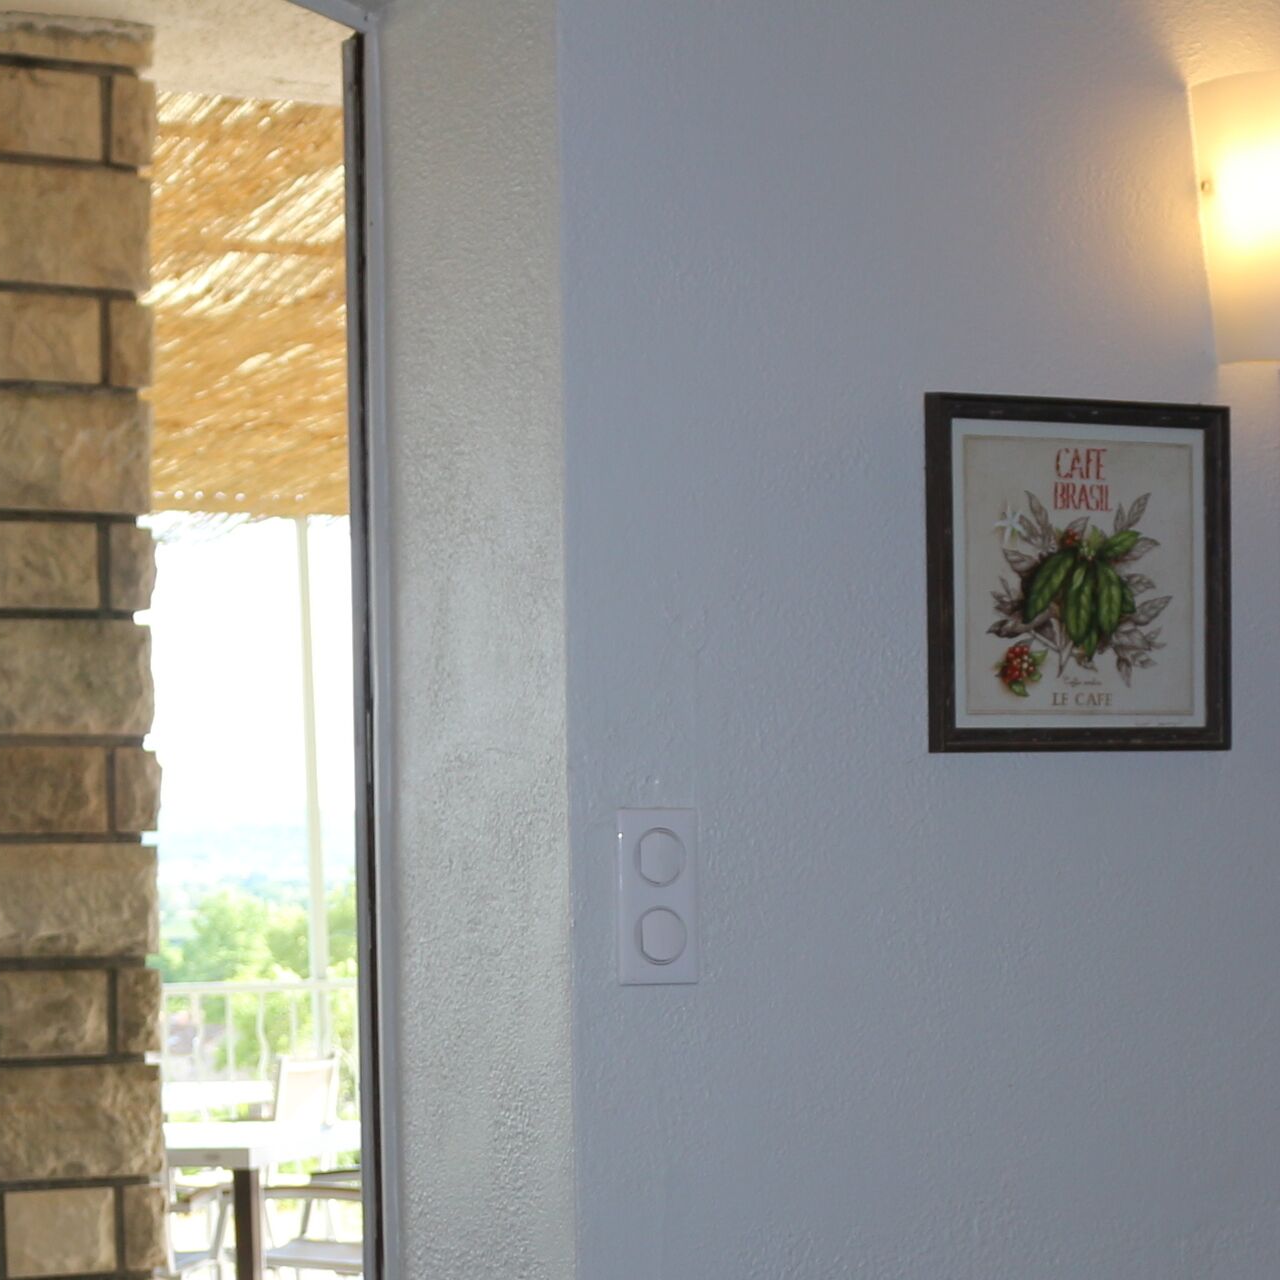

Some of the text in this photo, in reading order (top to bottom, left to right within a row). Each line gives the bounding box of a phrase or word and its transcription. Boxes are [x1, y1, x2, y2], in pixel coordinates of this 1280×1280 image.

[1055, 447, 1107, 480] CAFE
[1053, 481, 1113, 512] BRASIL
[1052, 692, 1113, 706] LE CAFE
